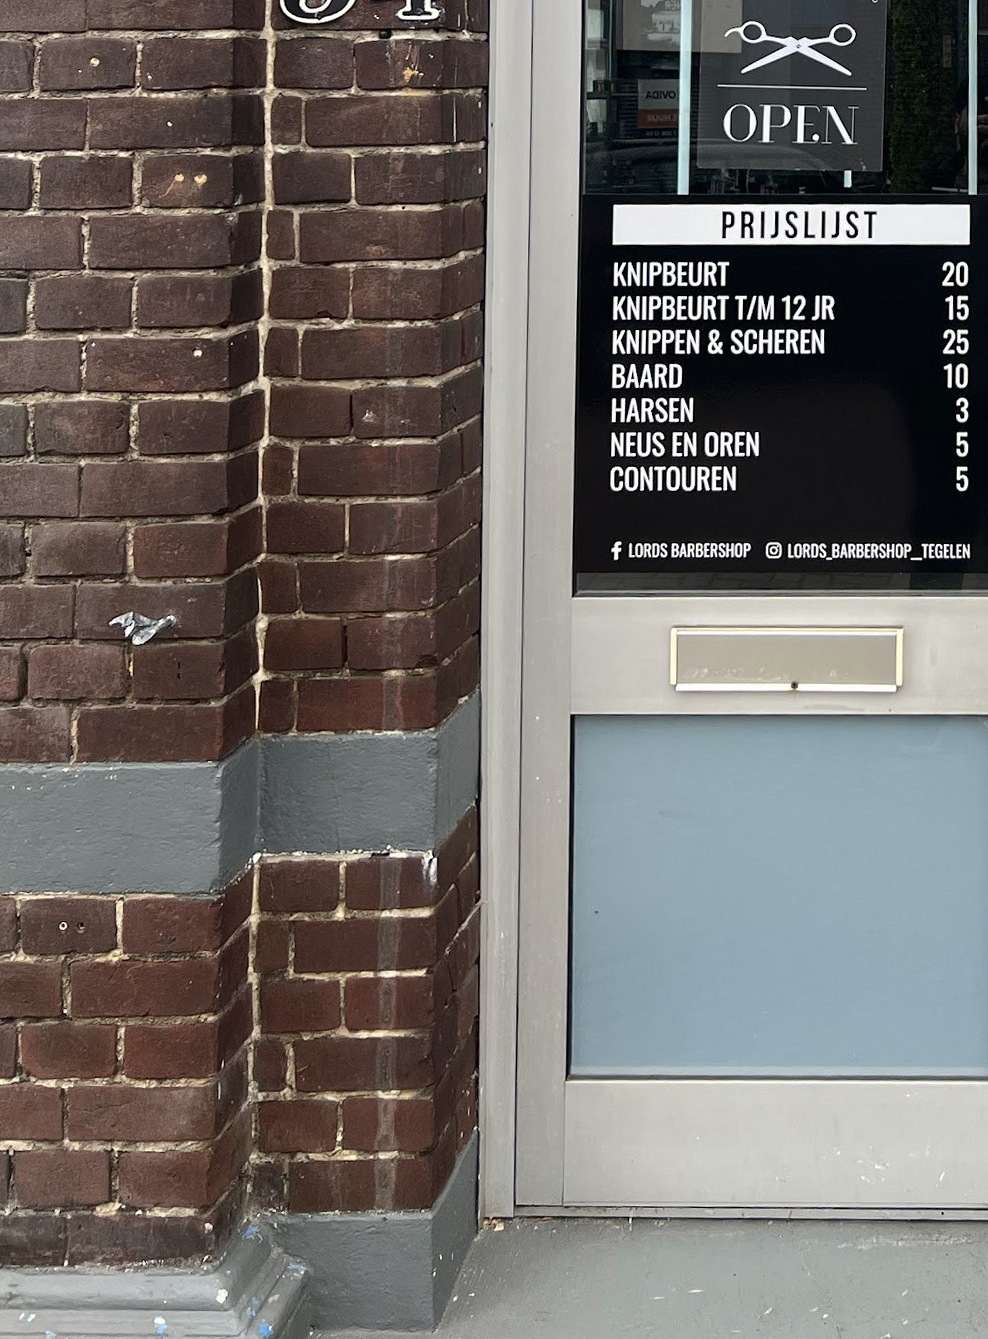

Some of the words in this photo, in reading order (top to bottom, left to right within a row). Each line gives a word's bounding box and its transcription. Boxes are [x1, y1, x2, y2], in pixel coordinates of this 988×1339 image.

[723, 103, 859, 145] OPEN
[722, 211, 877, 238] PRIJSLIJST
[614, 262, 729, 286] KNIPBEURT
[942, 262, 968, 286] 20
[613, 296, 729, 320] KNIPBEURT
[735, 296, 774, 320] T/M
[782, 295, 806, 320] 12
[812, 295, 834, 320] JR
[945, 295, 969, 320] 15
[612, 330, 700, 354] KNIPPEN
[708, 329, 723, 354] &
[731, 329, 824, 354] SCHEREN
[943, 329, 969, 354] 25
[612, 364, 682, 388] BAARD
[944, 363, 968, 388] 10
[612, 398, 693, 422] HARSEN
[956, 398, 968, 423] 3
[611, 432, 665, 457] NEUS
[672, 432, 697, 457] EN
[705, 432, 759, 457] OREN
[956, 432, 968, 457] 5
[610, 466, 736, 491] CONTOUREN
[956, 466, 968, 491] 5
[629, 543, 668, 558] LORDS
[671, 543, 751, 558] BARBERSHOP
